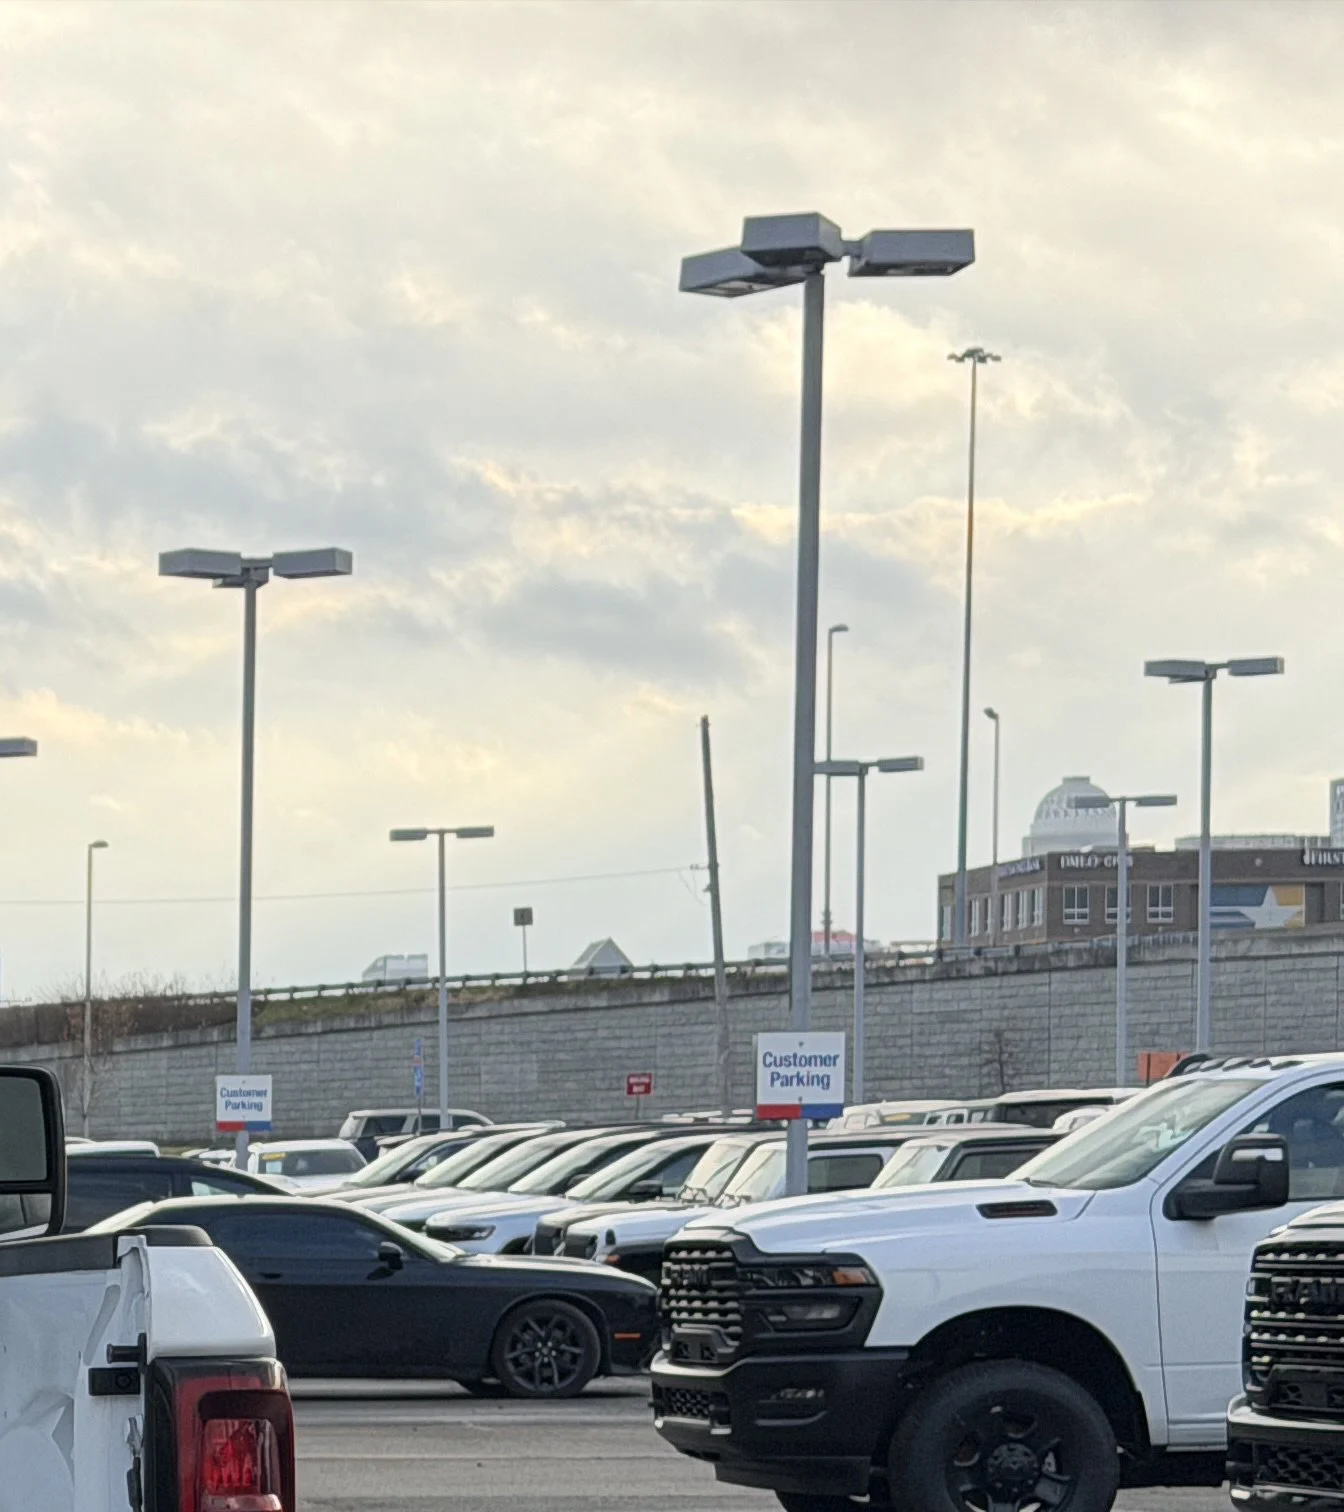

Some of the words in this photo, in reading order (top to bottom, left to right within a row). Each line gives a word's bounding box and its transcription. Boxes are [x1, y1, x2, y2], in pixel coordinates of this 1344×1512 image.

[762, 1051, 840, 1068] Customer
[770, 1071, 831, 1090] Parking
[220, 1087, 267, 1098] Customer
[225, 1101, 263, 1112] Parking
